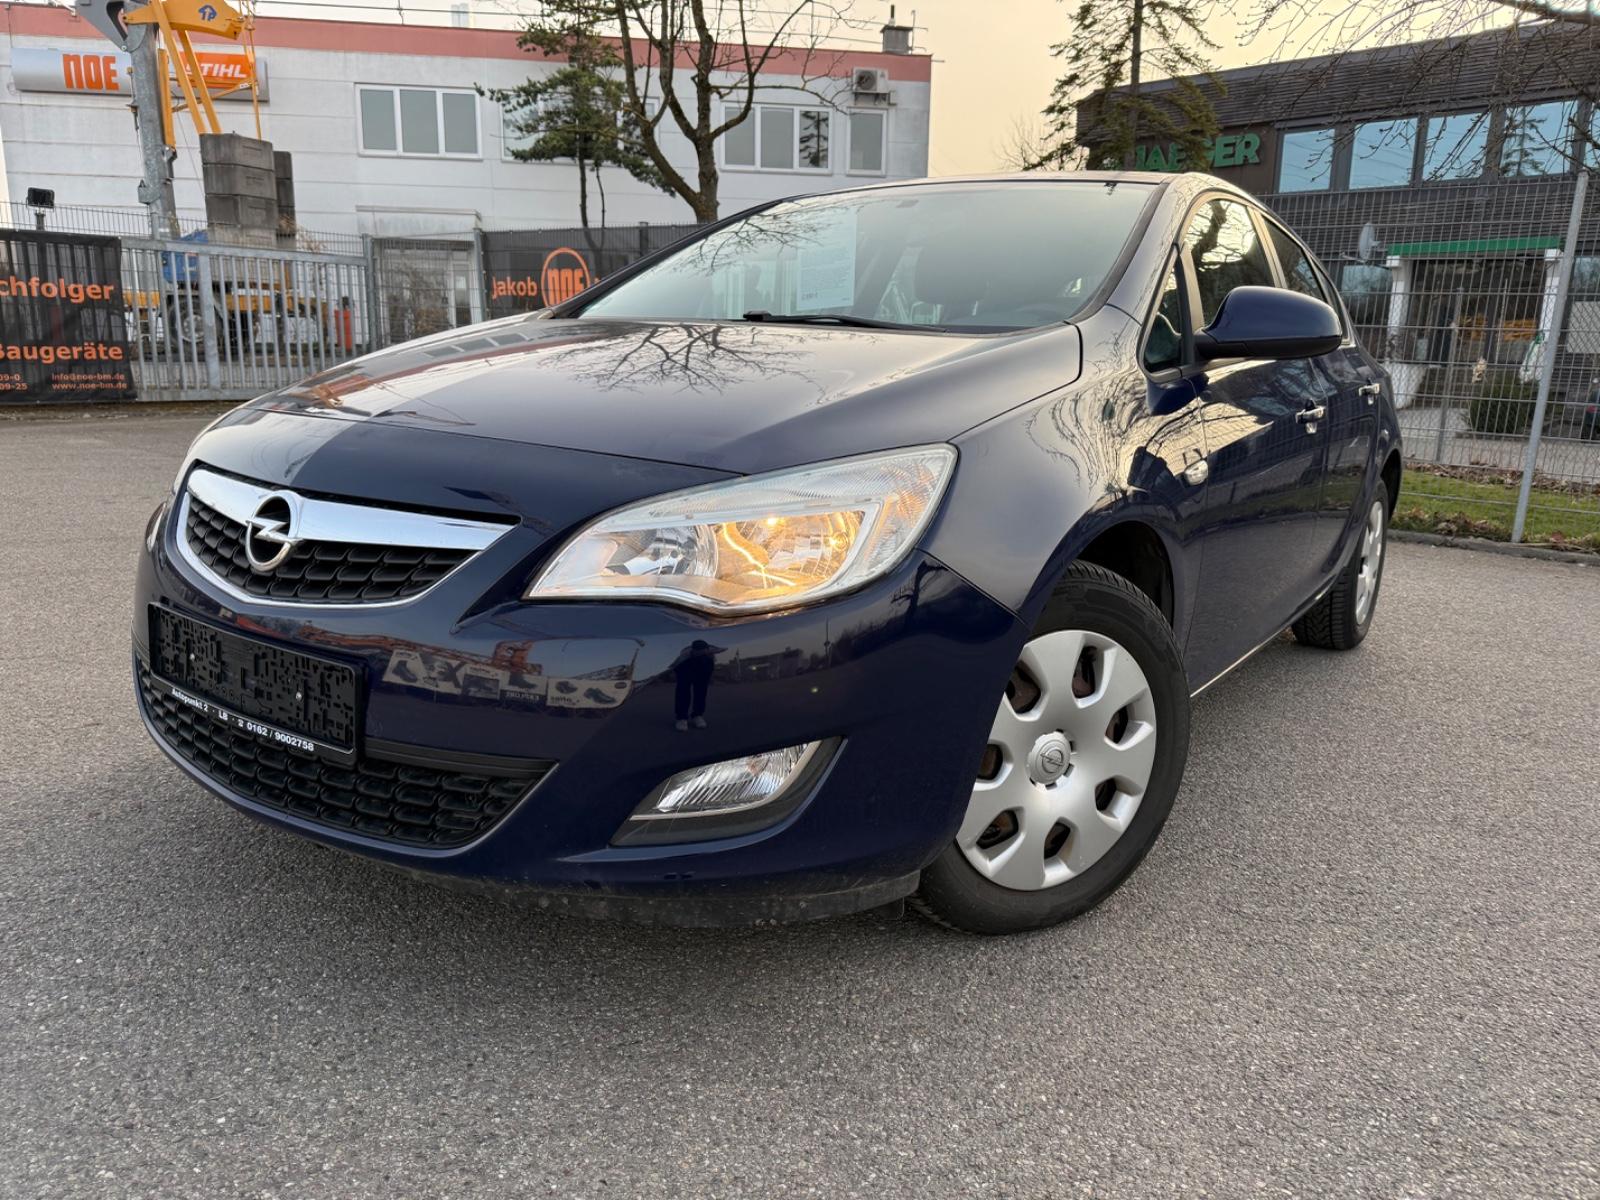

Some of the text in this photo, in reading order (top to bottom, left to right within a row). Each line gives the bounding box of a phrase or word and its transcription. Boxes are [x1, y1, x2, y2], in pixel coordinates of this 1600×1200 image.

[0, 275, 115, 304] chfolger
[203, 703, 209, 713] 2
[246, 722, 268, 736] 0162
[274, 731, 315, 751] 9002758
